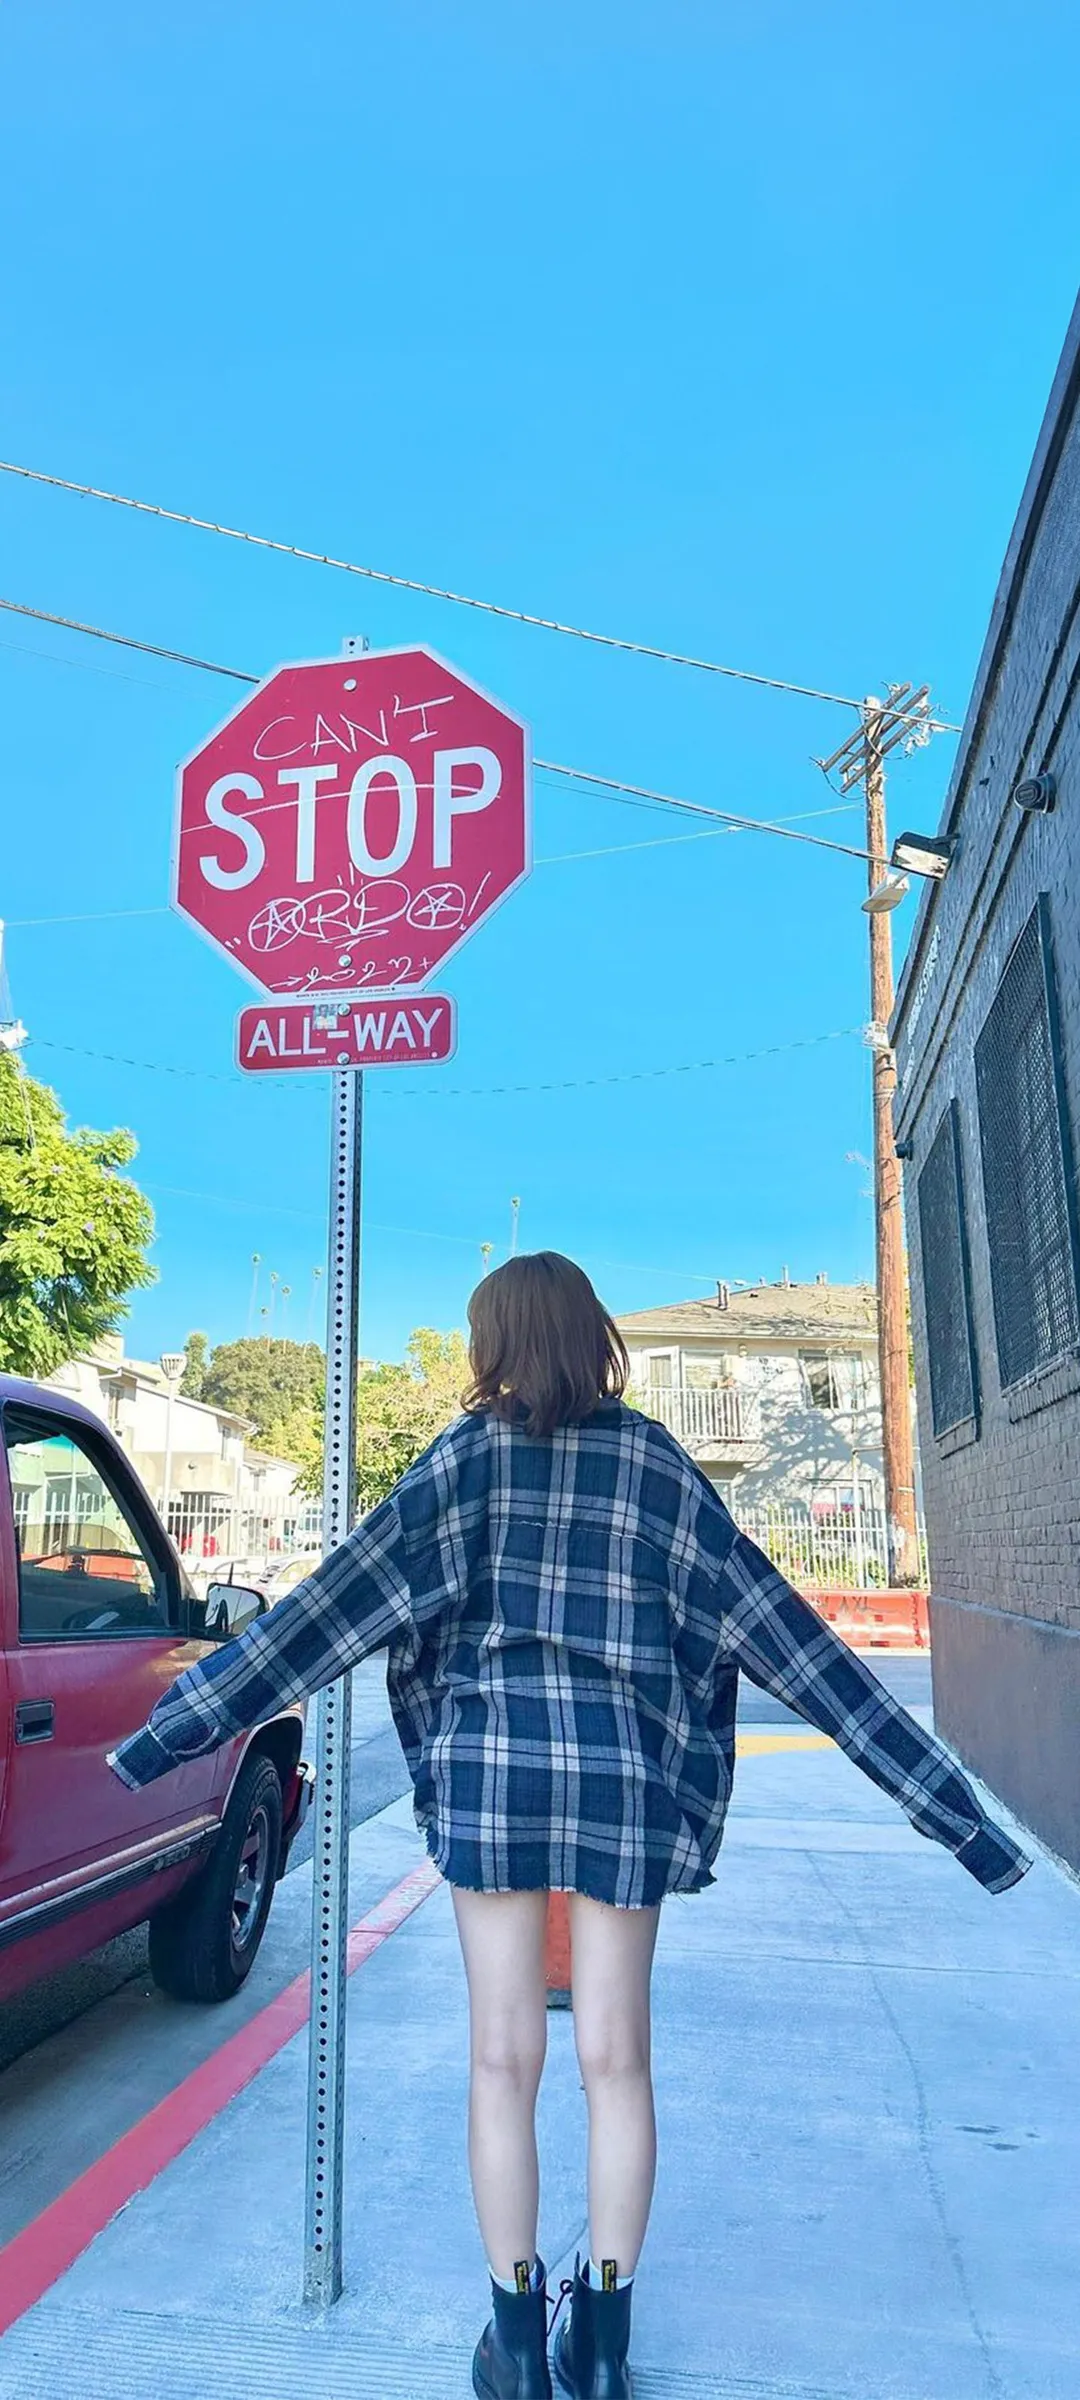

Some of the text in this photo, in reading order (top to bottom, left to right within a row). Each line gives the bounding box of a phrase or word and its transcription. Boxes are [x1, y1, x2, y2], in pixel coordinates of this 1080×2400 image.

[252, 695, 455, 761] CAN'T
[199, 745, 502, 891] STOP
[246, 1007, 444, 1059] ALL-WAY
